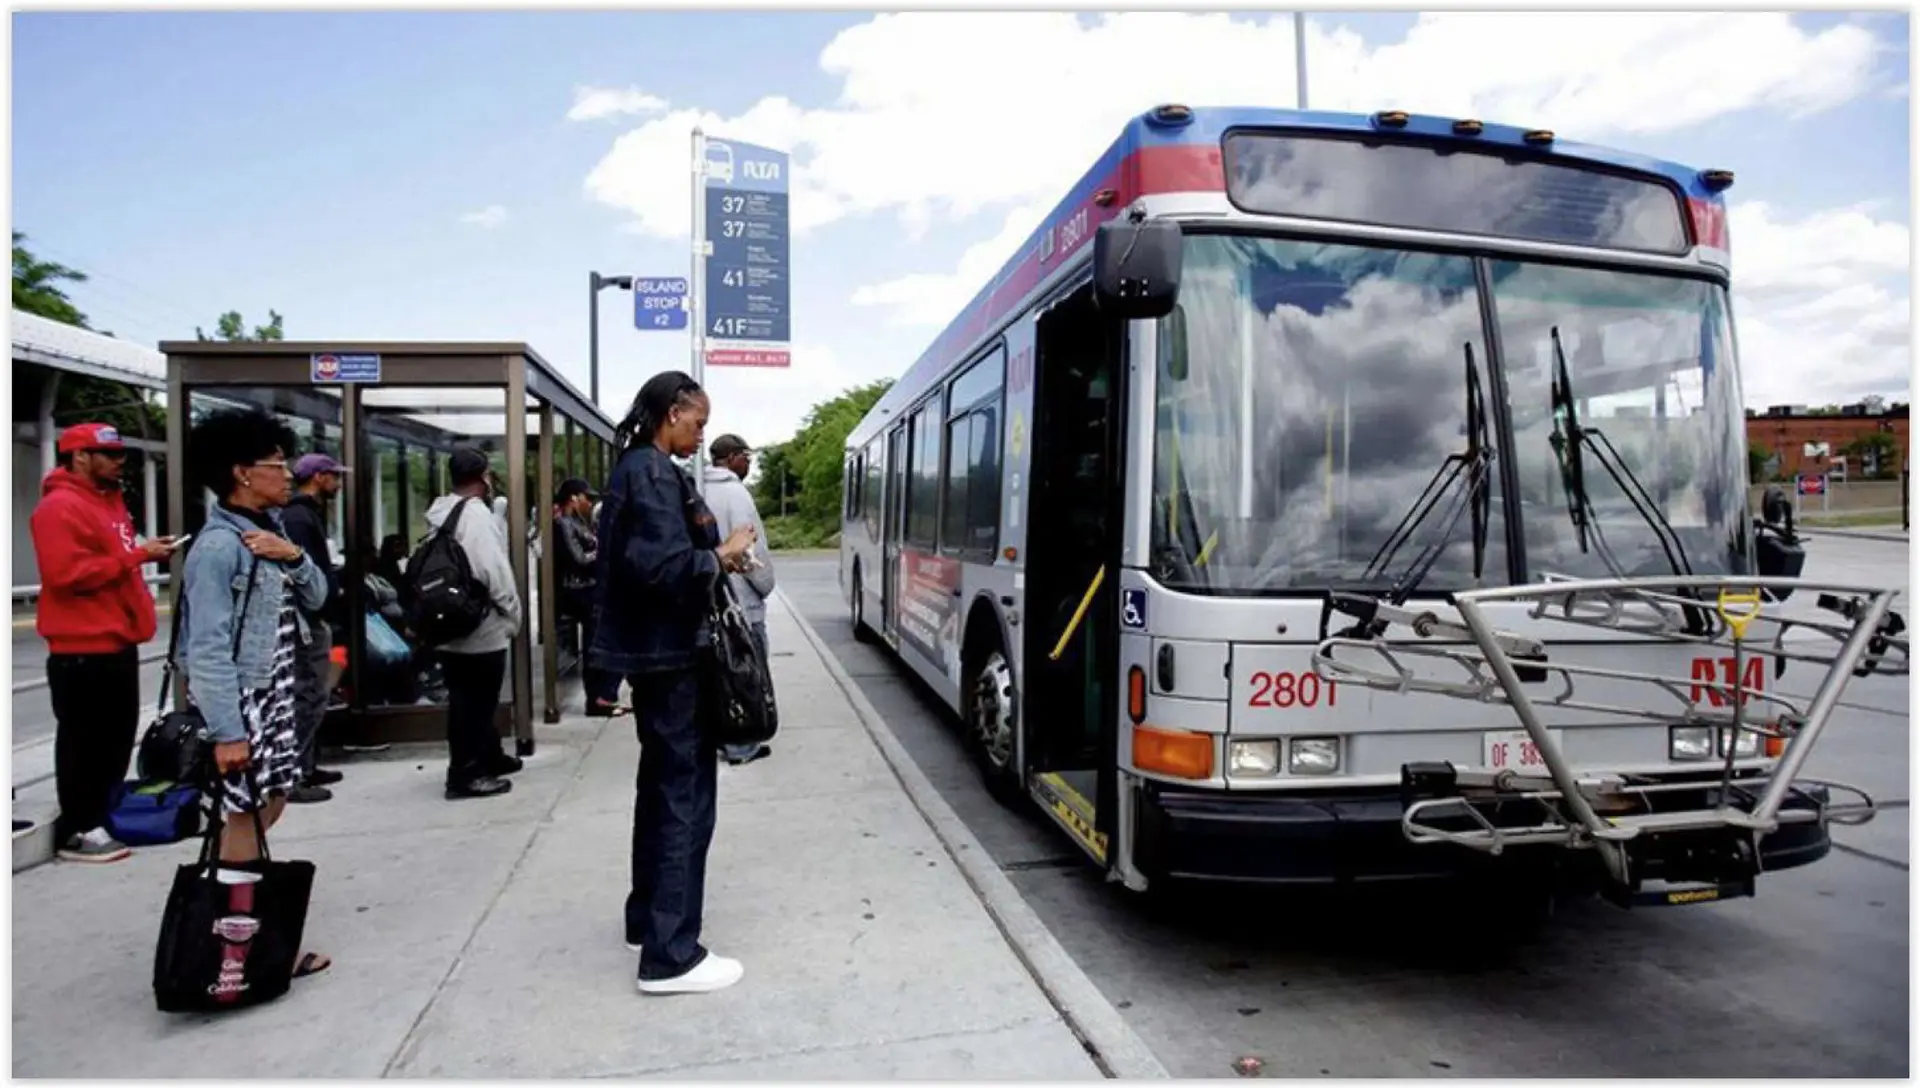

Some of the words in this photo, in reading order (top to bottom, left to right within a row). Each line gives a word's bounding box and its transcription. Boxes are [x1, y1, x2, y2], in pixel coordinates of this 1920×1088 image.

[722, 196, 745, 214] 37
[723, 220, 745, 238] 37
[637, 280, 686, 293] ISLAND
[723, 269, 744, 287] 41
[644, 296, 679, 309] STOP
[654, 313, 670, 326] #2
[712, 317, 747, 335] 41F
[1249, 671, 1336, 708] 2801
[1691, 656, 1764, 707] RTA
[1492, 743, 1509, 767] OF
